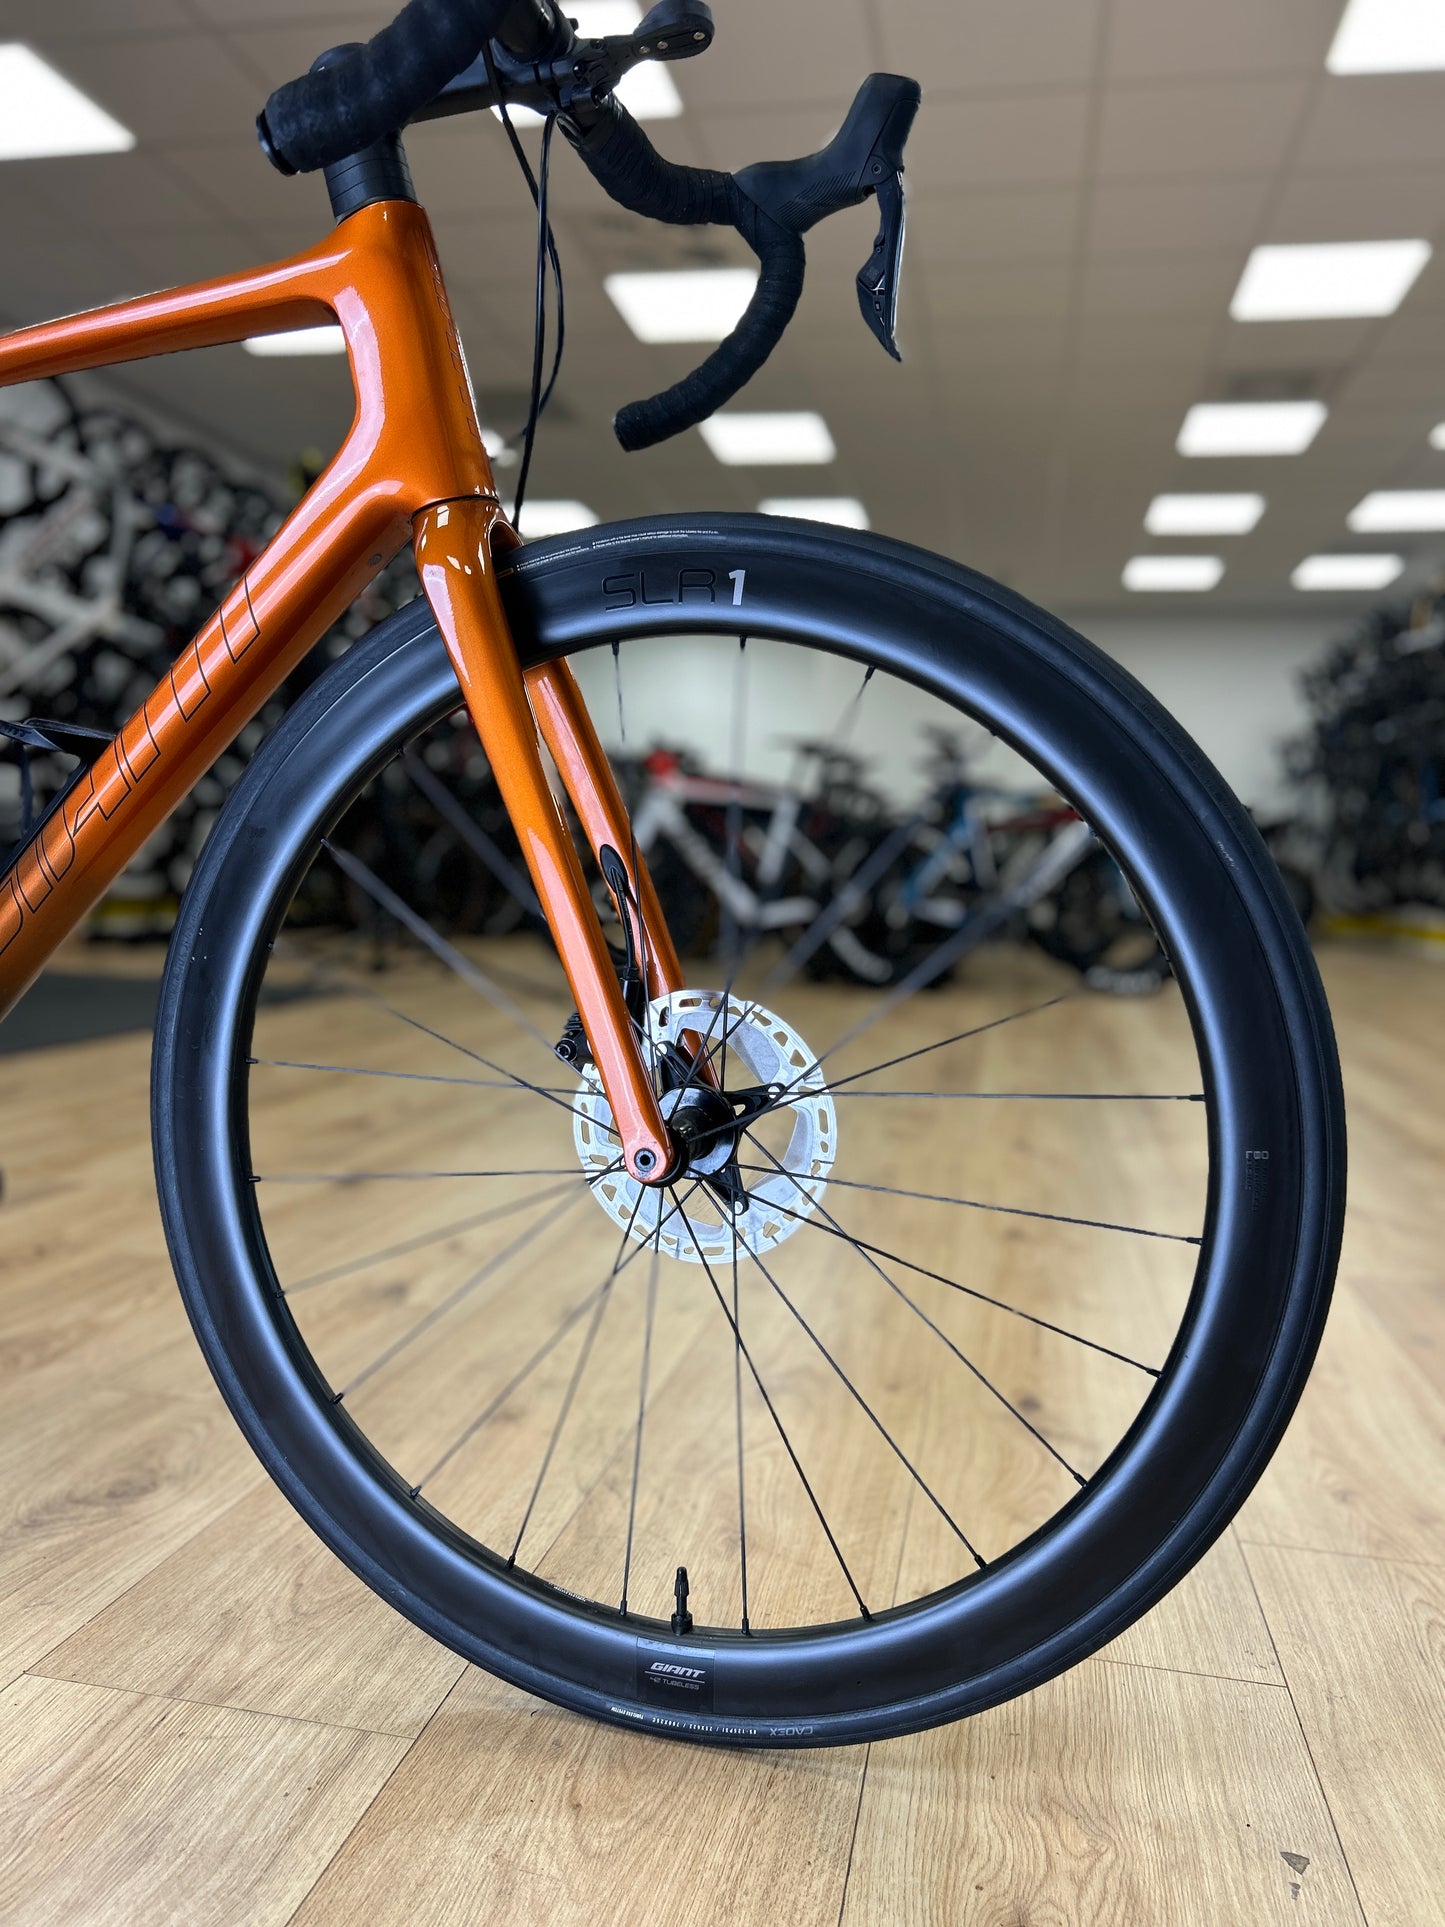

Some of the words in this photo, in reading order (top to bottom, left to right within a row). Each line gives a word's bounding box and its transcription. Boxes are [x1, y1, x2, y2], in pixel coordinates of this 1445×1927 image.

[602, 568, 716, 612] SLR
[728, 569, 746, 606] 1
[650, 1662, 705, 1678] GIANT
[662, 1678, 700, 1690] TUBELESS
[769, 1726, 813, 1737] CADEX
